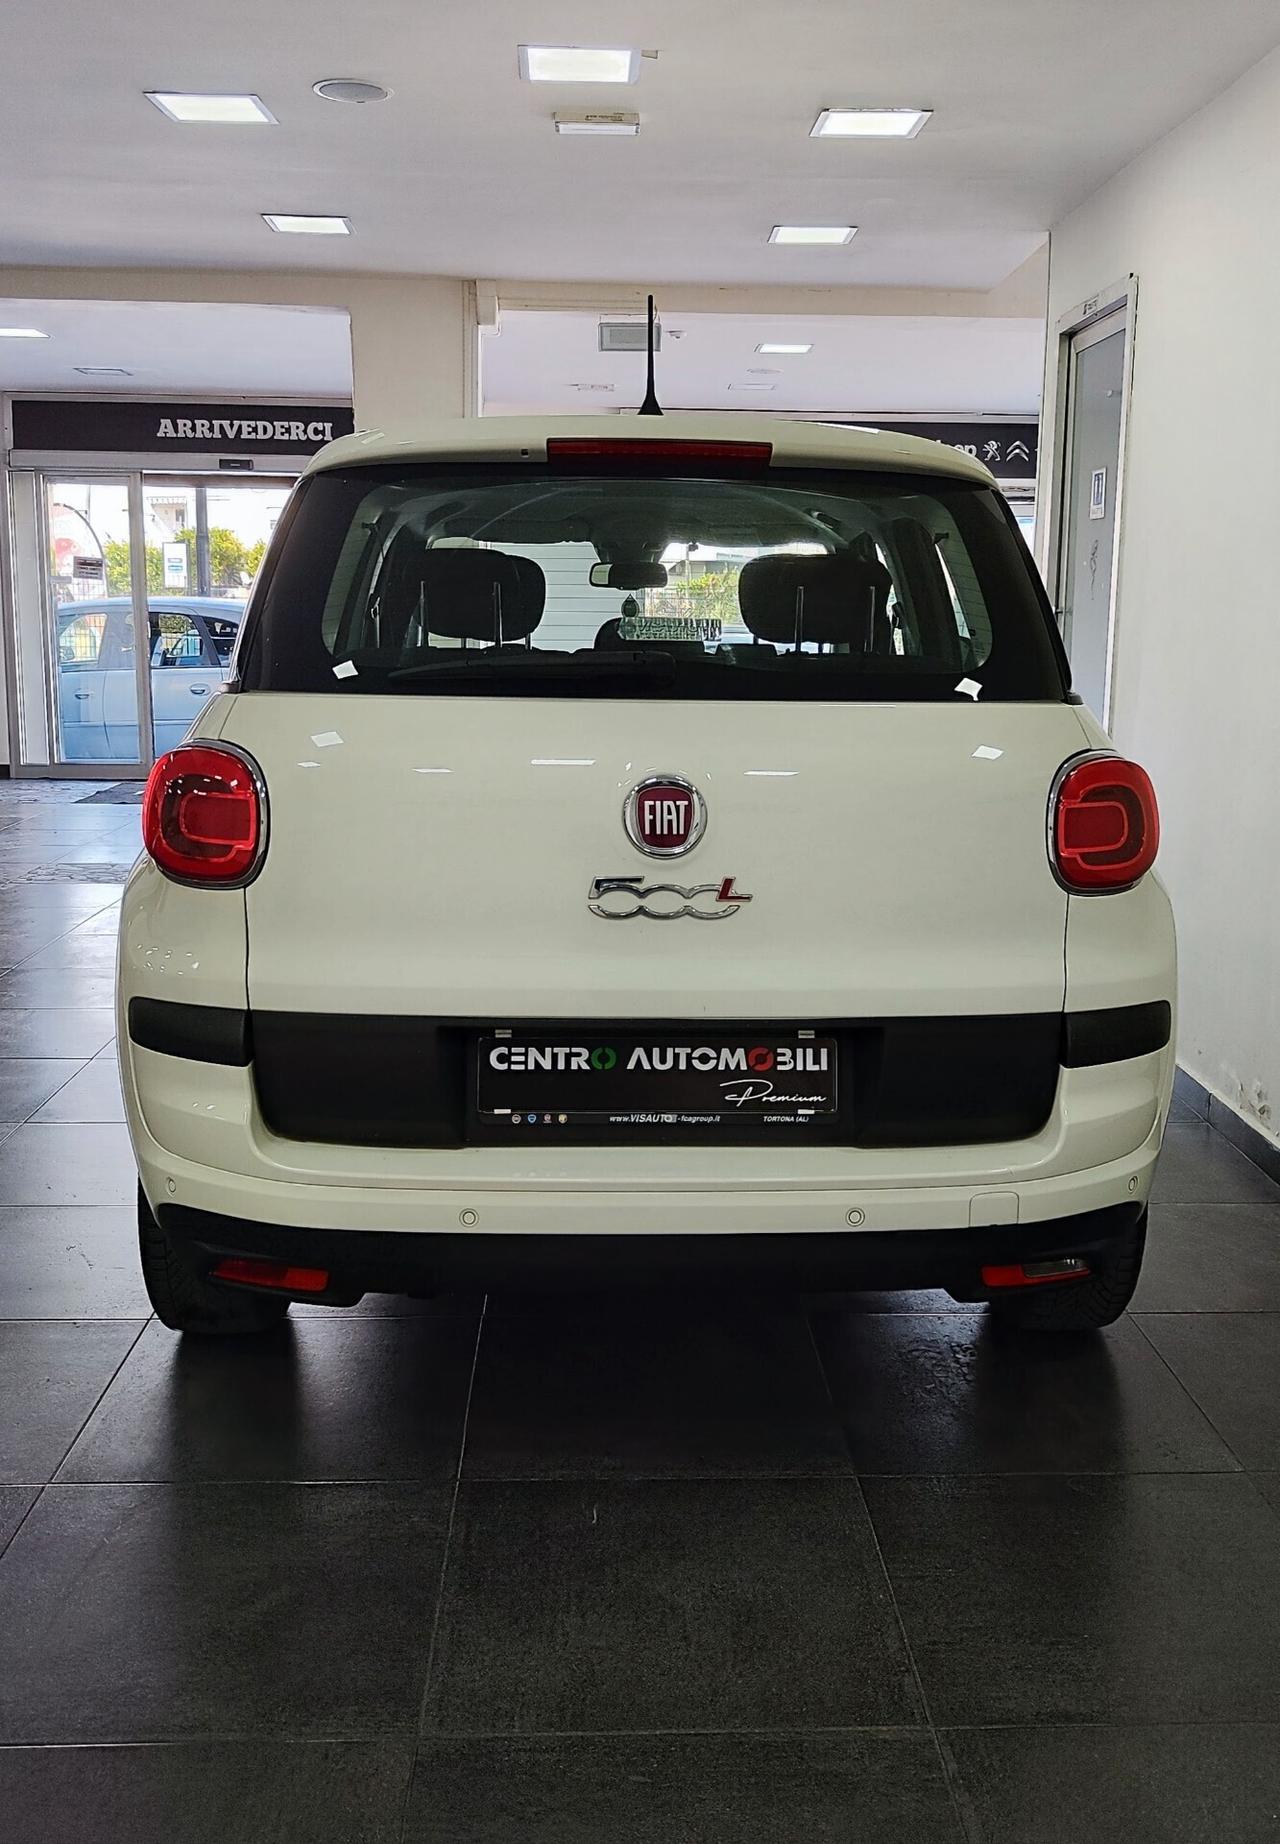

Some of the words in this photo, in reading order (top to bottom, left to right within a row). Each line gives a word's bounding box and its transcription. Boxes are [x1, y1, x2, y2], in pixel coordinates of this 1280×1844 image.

[157, 419, 333, 441] ARRIVEDERCI
[643, 800, 689, 835] FIAT
[588, 875, 753, 920] 500L
[489, 1046, 617, 1071] CENTRO
[626, 1046, 828, 1072] AUTOMOBILI
[719, 1078, 827, 1108] Premium
[763, 1115, 795, 1123] TORTONA
